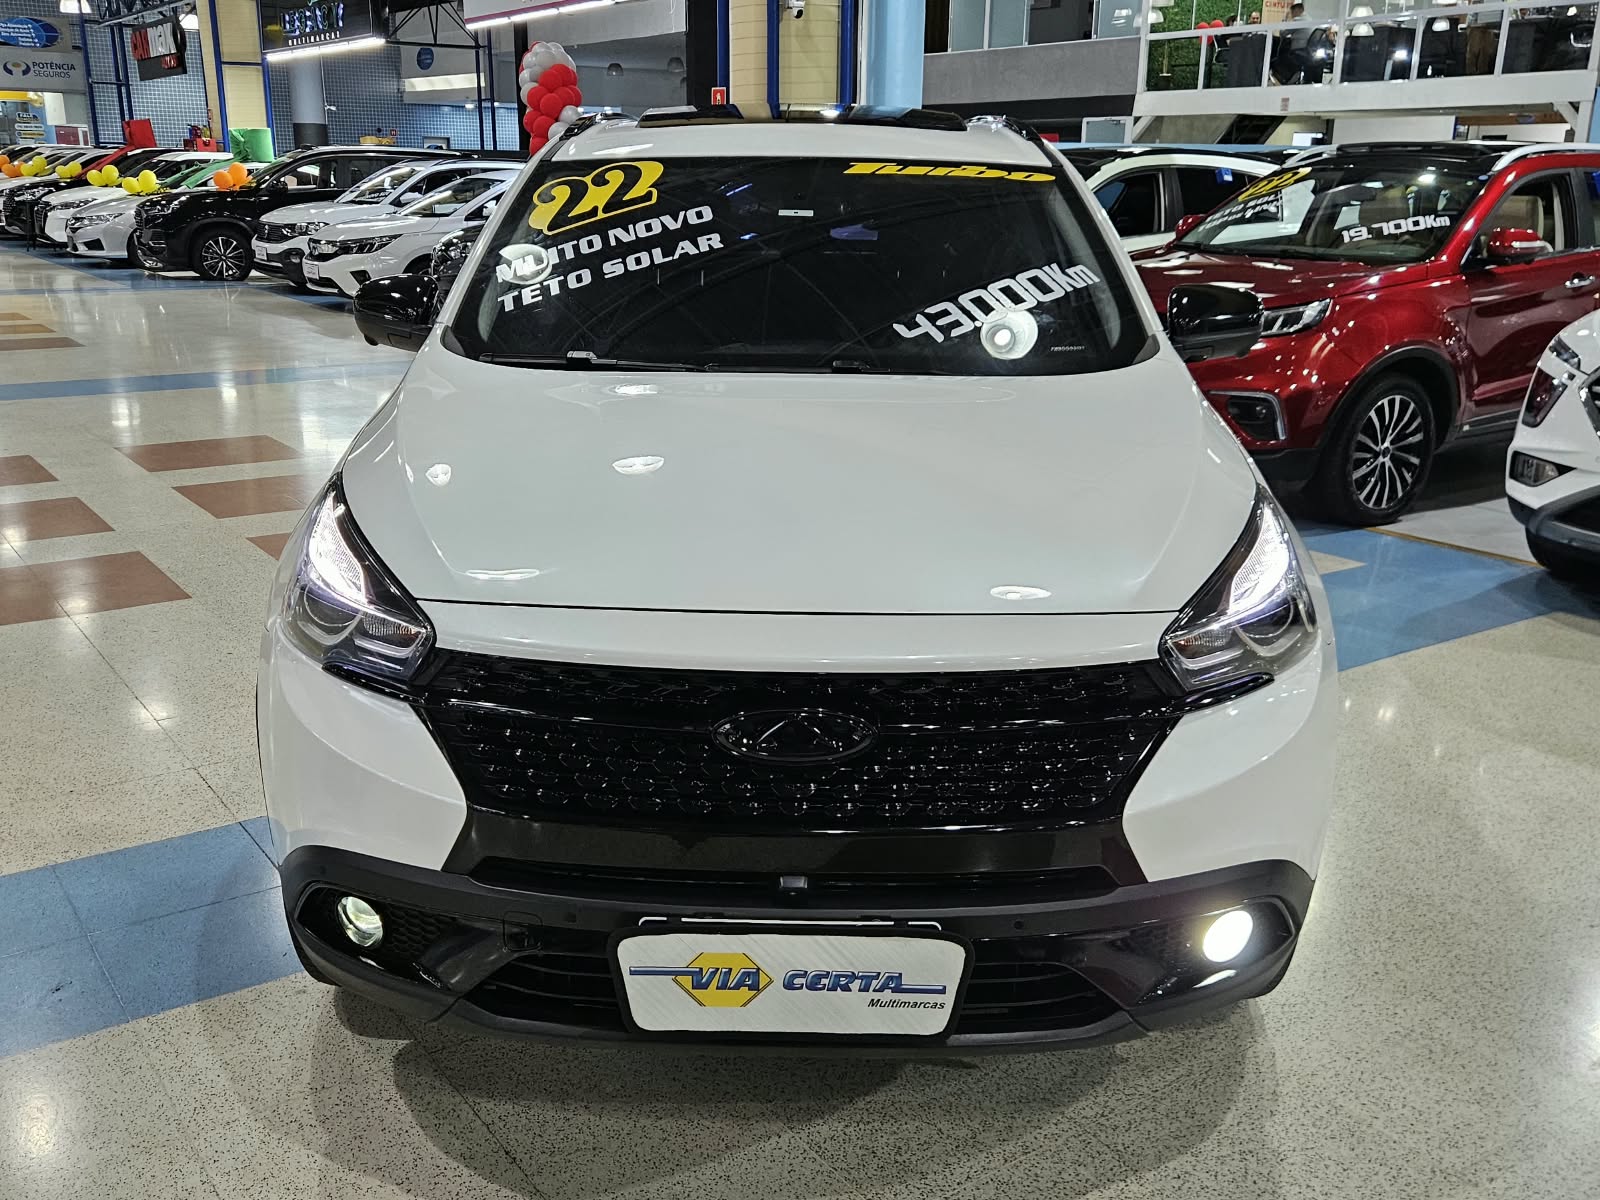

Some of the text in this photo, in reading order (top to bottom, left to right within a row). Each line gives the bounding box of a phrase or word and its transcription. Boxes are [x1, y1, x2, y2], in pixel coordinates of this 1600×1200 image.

[280, 3, 344, 35] LEGACY
[33, 69, 71, 79] SEGUROS
[843, 162, 1057, 182] Turbo
[528, 161, 664, 236] 22
[1341, 214, 1451, 243] 19.700Km
[495, 205, 714, 283] MUITO NOVO
[497, 232, 724, 313] TETO SOLAR
[892, 262, 1101, 344] 43.000Km
[690, 967, 904, 992] VIA CERTA
[867, 998, 946, 1011] Multimarcas
